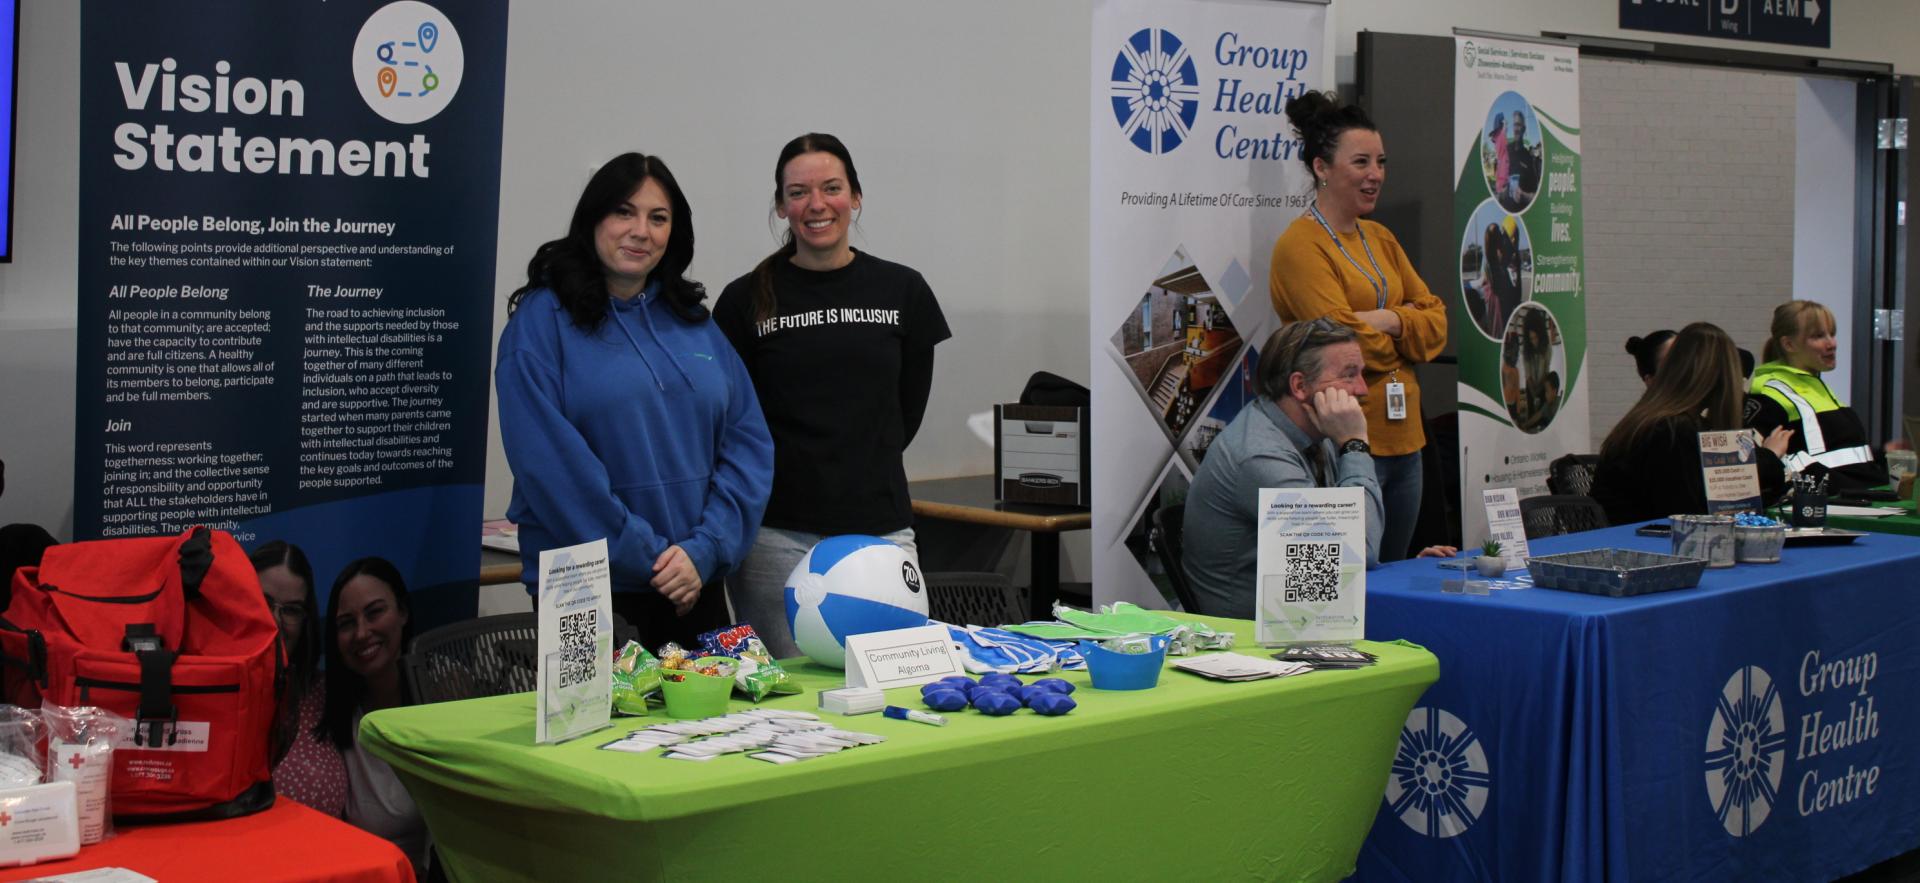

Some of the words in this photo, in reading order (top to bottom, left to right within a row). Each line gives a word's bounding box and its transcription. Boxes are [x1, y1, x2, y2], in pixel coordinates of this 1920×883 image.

[1721, 19, 1738, 33] Wing
[1215, 32, 1307, 80] Group
[114, 57, 304, 116] Vision
[1213, 78, 1306, 115] Heal
[113, 122, 430, 178] Statement
[1548, 167, 1576, 198] people.
[1121, 192, 1168, 208] Providing
[1170, 193, 1177, 205] A
[1179, 192, 1218, 206] Lifetime
[1220, 193, 1232, 206] Of
[1233, 194, 1254, 207] Care
[1256, 194, 1281, 207] Since
[1284, 195, 1307, 207] 1963
[1550, 203, 1573, 216] Building
[110, 214, 134, 230] All
[137, 215, 199, 233] People
[202, 215, 265, 234] Belong,
[267, 216, 299, 232] Join
[302, 217, 330, 232] the
[333, 217, 396, 236] Journey
[1551, 217, 1571, 242] lives.
[110, 242, 129, 251] The
[131, 242, 178, 254] following
[180, 242, 212, 254] points
[214, 243, 252, 254] provide
[253, 243, 298, 253] additional
[300, 243, 357, 255] perspective
[359, 244, 376, 254] and
[378, 244, 442, 255] understanding
[443, 244, 453, 254] of
[109, 255, 126, 265] the
[128, 255, 147, 267] key
[148, 255, 188, 266] themes
[189, 256, 240, 266] contained
[242, 256, 270, 266] within
[271, 258, 287, 266] our
[289, 256, 319, 266] Vision
[1537, 255, 1577, 267] Strengthening
[1534, 267, 1582, 297] community.
[108, 284, 127, 297] All
[129, 284, 178, 300] People
[180, 285, 229, 300] Belong
[307, 284, 331, 297] The
[333, 284, 383, 299] Journey
[108, 309, 121, 319] All
[123, 309, 158, 321] people
[160, 309, 170, 319] in
[171, 311, 178, 319] a
[180, 309, 237, 320] community
[238, 309, 271, 320] belong
[305, 307, 325, 318] The
[326, 307, 348, 318] road
[350, 308, 360, 317] to
[361, 307, 404, 318] achieving
[405, 307, 445, 316] inclusion
[108, 324, 119, 333] to
[120, 322, 141, 333] that
[206, 324, 223, 332] are
[304, 321, 324, 331] and
[324, 320, 342, 330] the
[342, 321, 384, 332] supports
[384, 320, 419, 330] needed
[419, 319, 431, 330] by
[431, 319, 459, 329] those
[756, 317, 778, 337] THE
[780, 310, 824, 329] FUTURE
[826, 308, 838, 324] IS
[841, 308, 899, 325] INCLUSIVE
[107, 337, 132, 346] have
[133, 336, 151, 346] the
[152, 335, 197, 348] capacity
[198, 336, 210, 346] to
[211, 335, 262, 346] contribute
[107, 350, 125, 360] and
[127, 352, 144, 360] are
[146, 349, 162, 360] full
[208, 349, 216, 359] A
[218, 348, 253, 360] healthy
[106, 363, 165, 375] community
[165, 363, 175, 373] is
[176, 365, 197, 373] one
[197, 362, 220, 373] that
[220, 362, 251, 372] allows
[252, 361, 263, 371] all
[264, 361, 275, 371] of
[106, 378, 119, 388] its
[120, 377, 169, 387] members
[171, 377, 183, 387] to
[223, 375, 274, 387] participate
[105, 391, 125, 402] and
[126, 391, 140, 401] be
[141, 390, 158, 401] full
[105, 418, 132, 432] Join
[104, 443, 126, 453] This
[126, 441, 155, 452] word
[155, 440, 213, 453] represents
[1713, 433, 1728, 447] WISH
[176, 453, 218, 465] working
[103, 470, 137, 482] joining
[152, 468, 172, 478] and
[174, 467, 192, 478] the
[193, 465, 241, 477] collective
[242, 465, 269, 474] sense
[869, 648, 919, 663] Community
[921, 644, 946, 658] Living
[898, 663, 930, 675] Algoma
[1800, 649, 1877, 697] Group
[1795, 697, 1879, 761] Health
[1798, 764, 1879, 817] Centre
